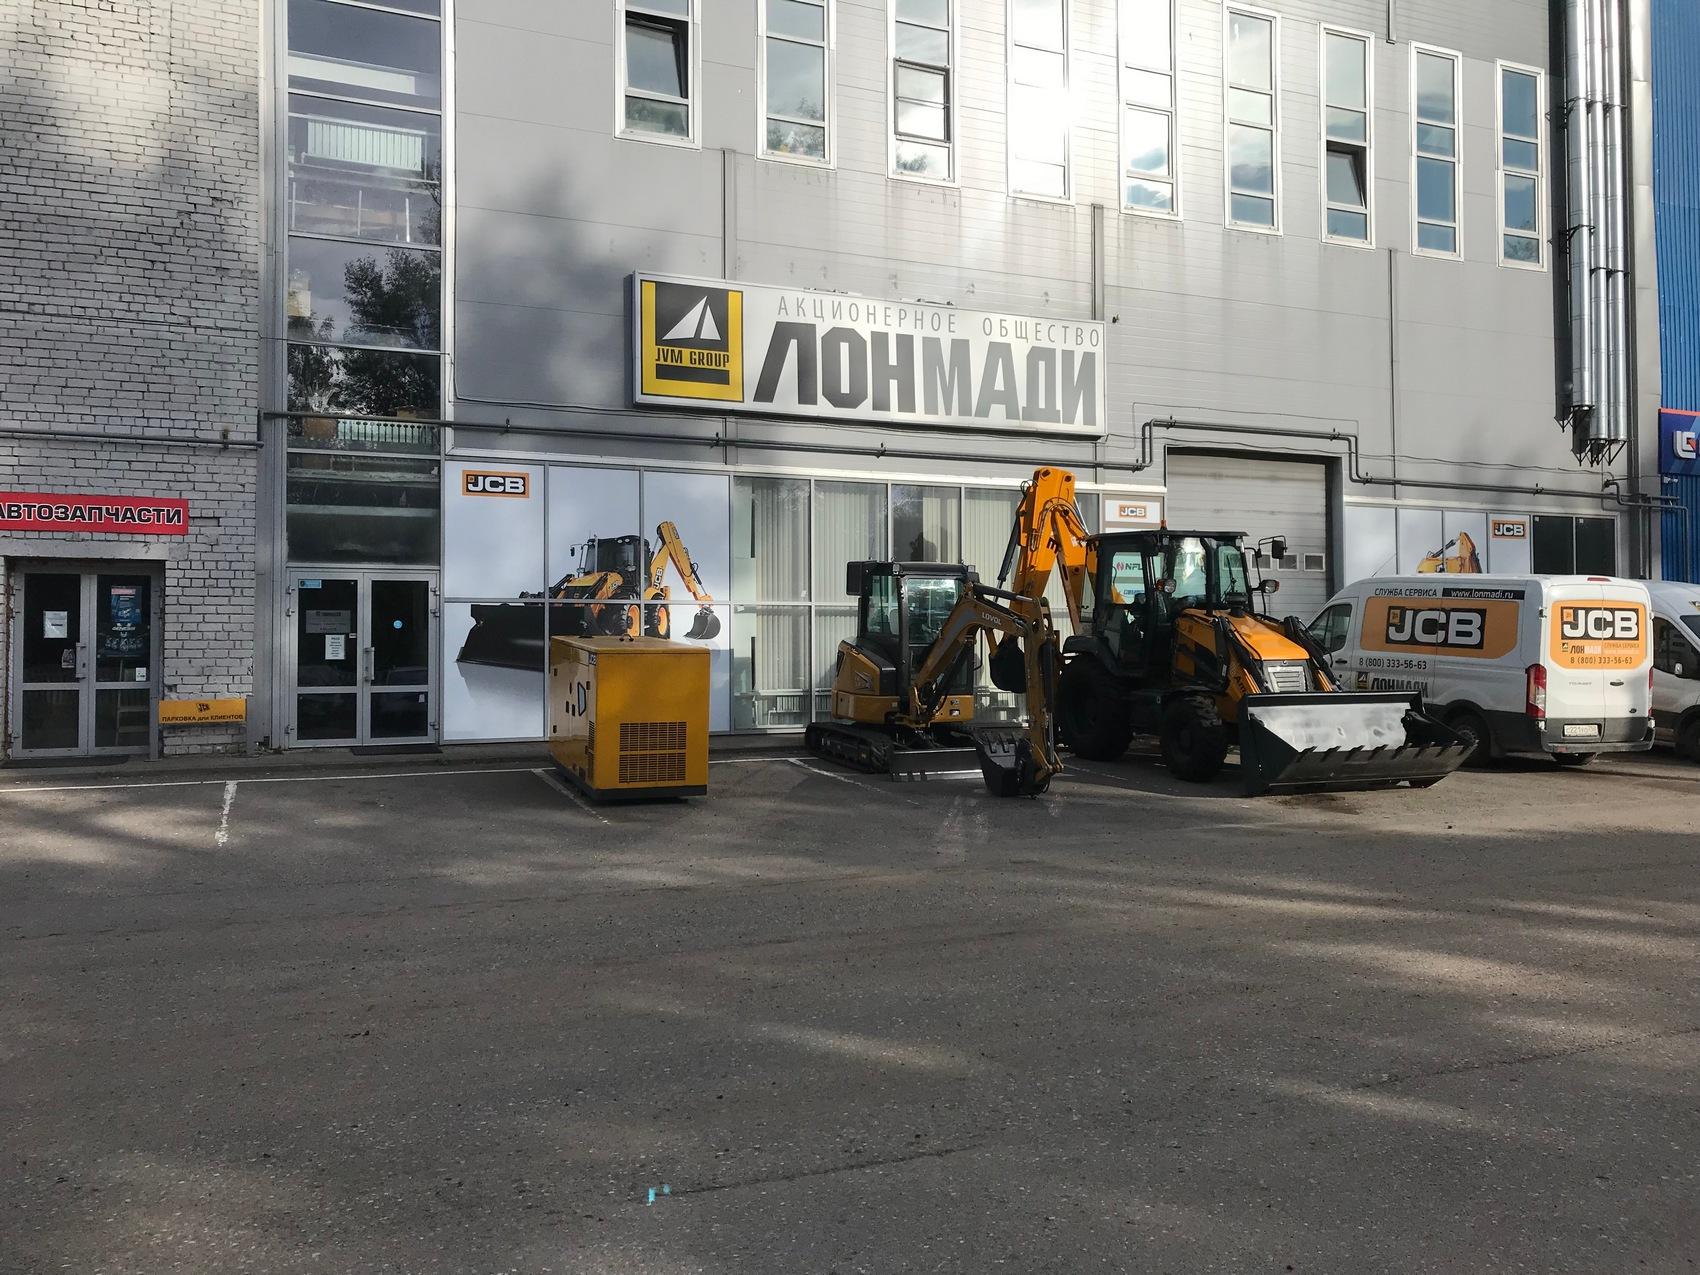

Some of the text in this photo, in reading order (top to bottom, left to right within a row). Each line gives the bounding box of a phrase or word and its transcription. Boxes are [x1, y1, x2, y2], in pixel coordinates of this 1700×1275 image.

[778, 295, 1100, 348] АКЦИОНЕРНОЕ ОБЩЕСТВО
[655, 348, 730, 368] JVM GROUP
[753, 320, 1097, 426] ЛОНМАДИ
[467, 475, 525, 494] JCB
[1120, 507, 1145, 517] JCB
[1494, 524, 1524, 536] JCB
[1374, 588, 1438, 597] СЛУЖБА СЕРВИСА
[1451, 589, 1514, 599] www.lonmadi.ru
[981, 612, 1002, 625] LOVOL
[1563, 609, 1638, 639] JCB
[1388, 609, 1482, 645] JCB
[1359, 657, 1427, 670] 8 (800) 333-56-63
[1577, 656, 1597, 665] (800)
